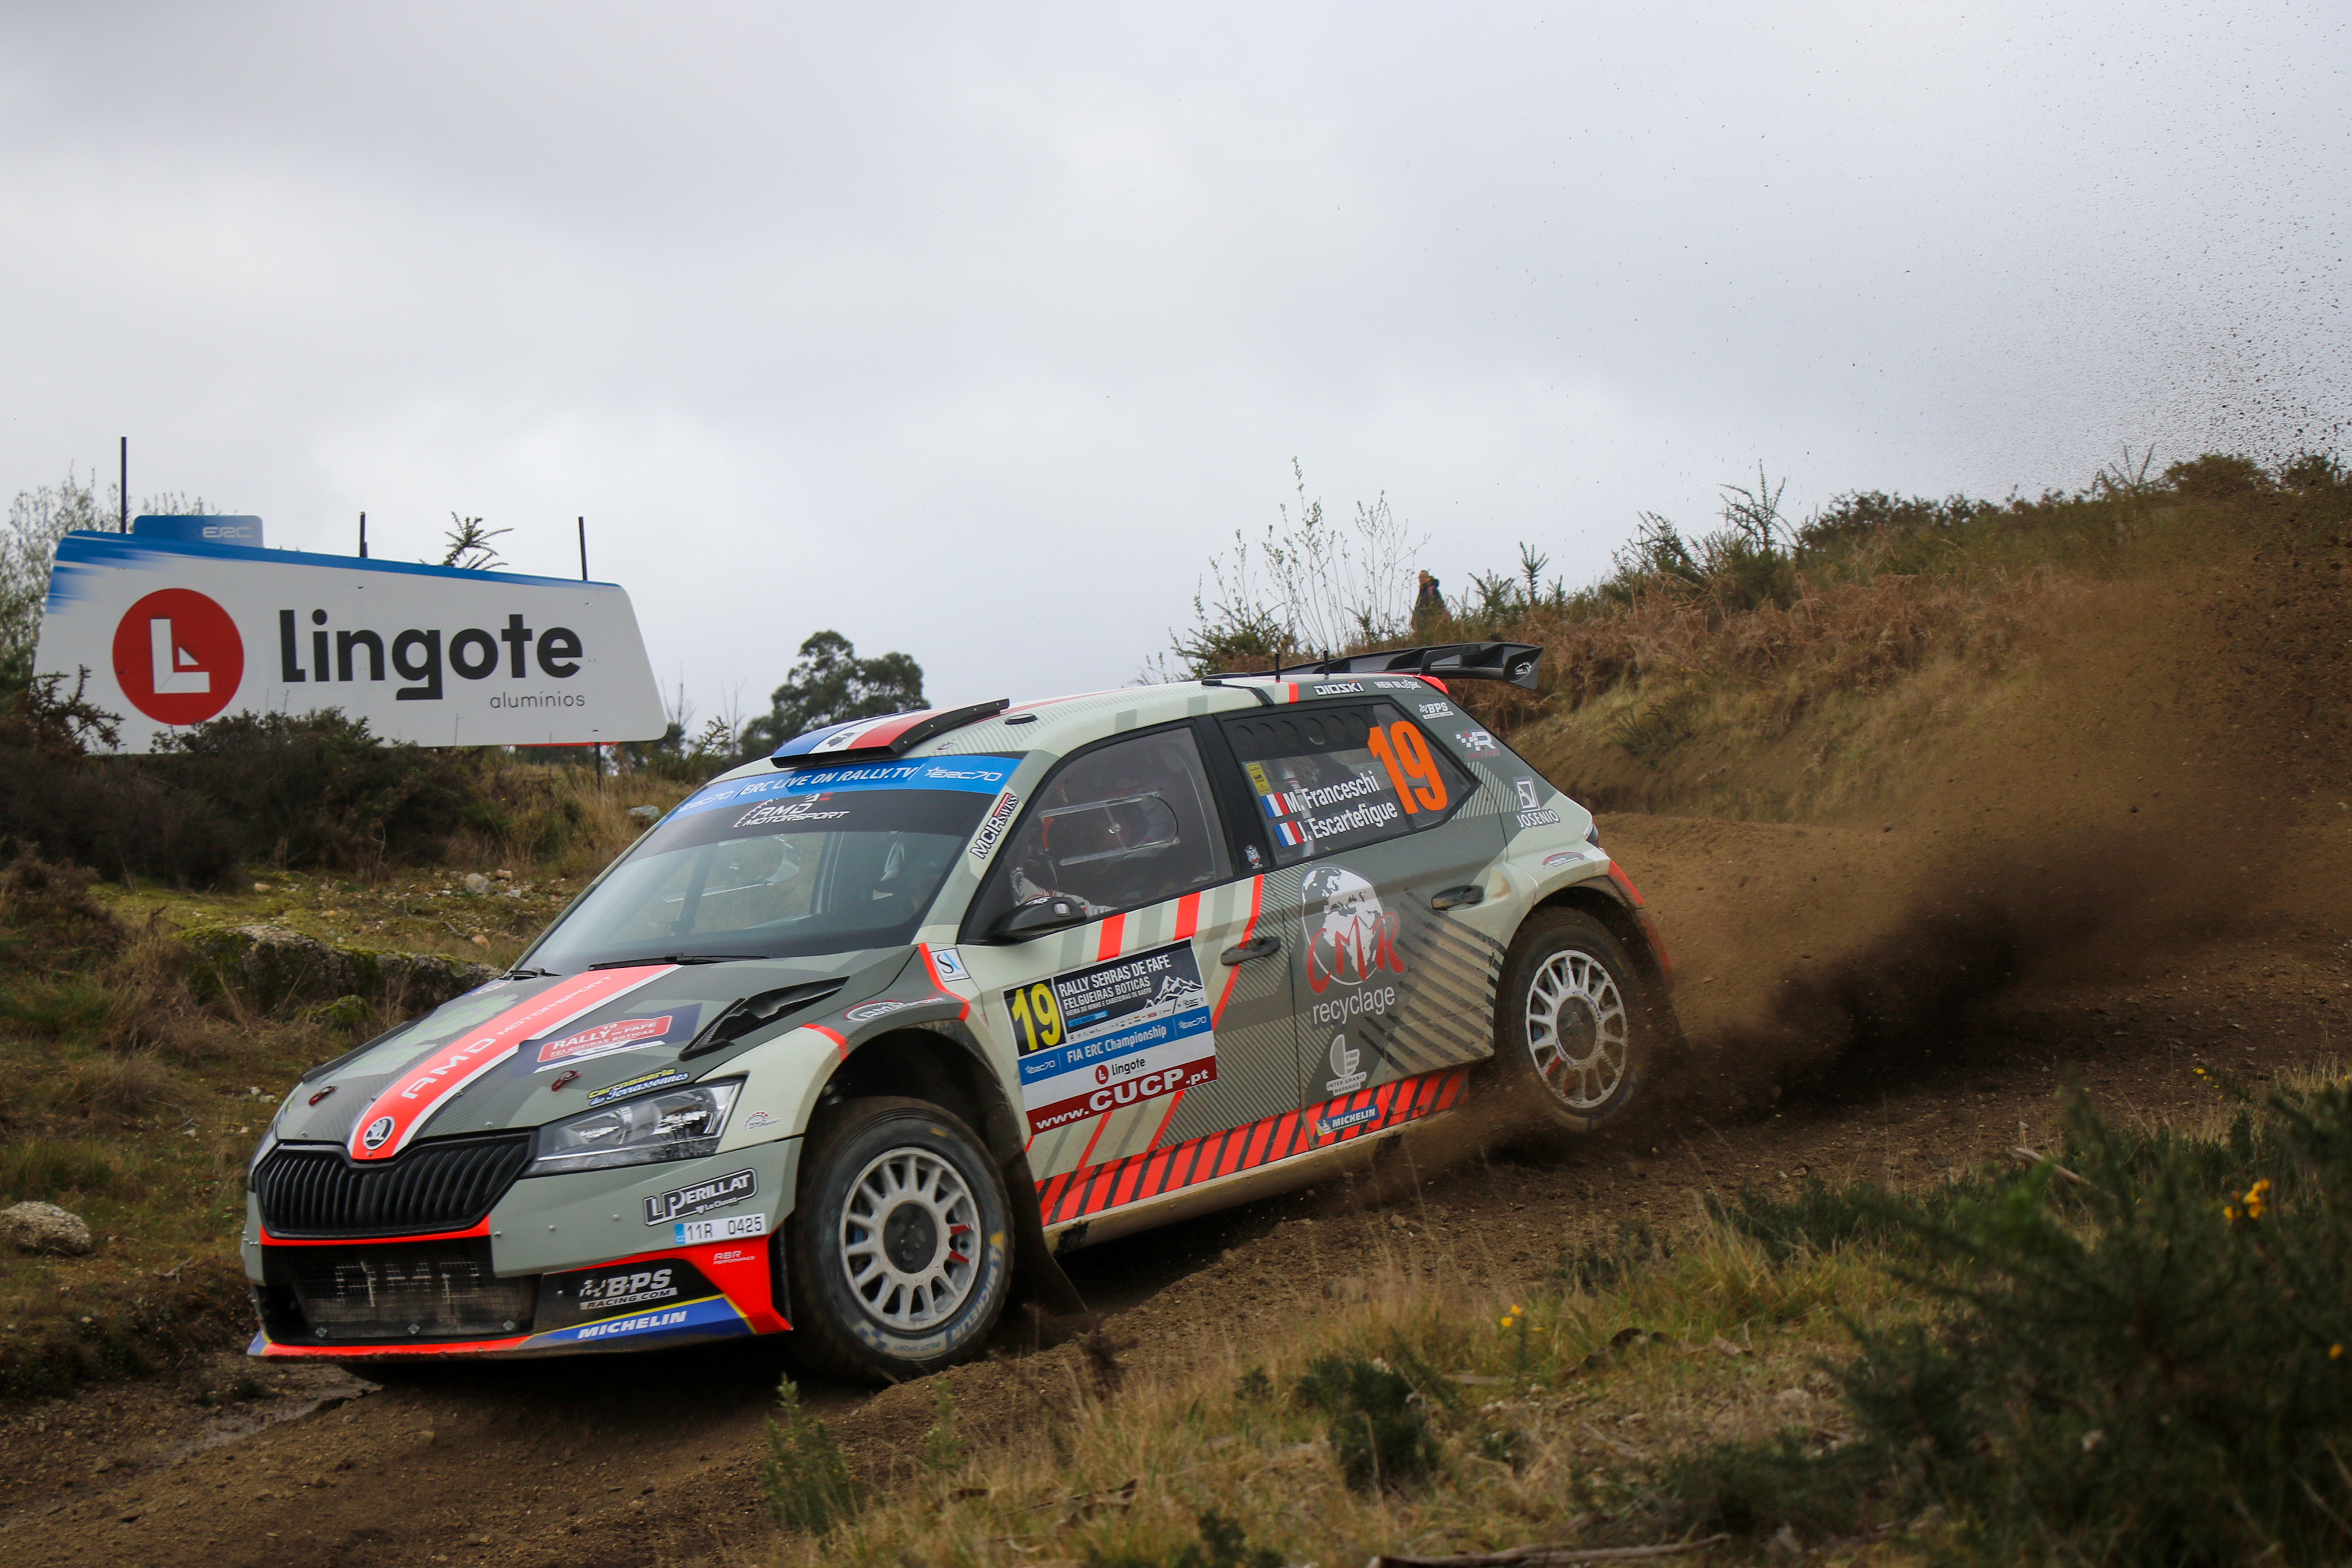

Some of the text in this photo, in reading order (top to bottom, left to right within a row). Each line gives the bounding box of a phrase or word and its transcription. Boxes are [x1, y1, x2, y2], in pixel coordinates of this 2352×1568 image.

[203, 526, 252, 538] ERC
[490, 691, 585, 708] alumínios
[1427, 701, 1449, 714] BPS
[740, 766, 920, 796] ERC LIVE ON RALLY.TV
[1368, 720, 1447, 815] 19
[1283, 791, 1305, 813] M.
[1301, 770, 1381, 809] Franceschi
[742, 811, 850, 827] MOTORSPORT
[1297, 801, 1398, 842] J. Escartefigue
[1516, 810, 1559, 827] JOSENIO
[1306, 912, 1405, 994] CMR
[1058, 954, 1172, 998] RALLY SERRAS DE FAFE
[497, 975, 611, 1035] MOTORSPORT
[1063, 975, 1151, 1010] FELGUEIRAS BOTICAS
[1313, 986, 1395, 1025] recyclage
[1011, 982, 1062, 1052] 19
[551, 1038, 610, 1056] FELGUEIRAS
[612, 1028, 655, 1041] BOTICAS
[552, 1029, 611, 1050] RALLY
[624, 1022, 657, 1034] FAFE
[1066, 1048, 1084, 1064] FIA
[1084, 1042, 1104, 1058] ERC
[1105, 1024, 1167, 1053] Championship
[402, 1038, 496, 1100] AMD
[1327, 1074, 1365, 1088] INTER GRANIT
[1333, 1082, 1359, 1094] MARBRIER
[1332, 1107, 1376, 1128] MICHELIN
[687, 1216, 763, 1240] 11R 0425
[714, 1250, 742, 1261] ABR
[605, 1268, 673, 1297] BPS
[586, 1289, 671, 1309] RACING.COM
[577, 1310, 687, 1340] MICHELIN
